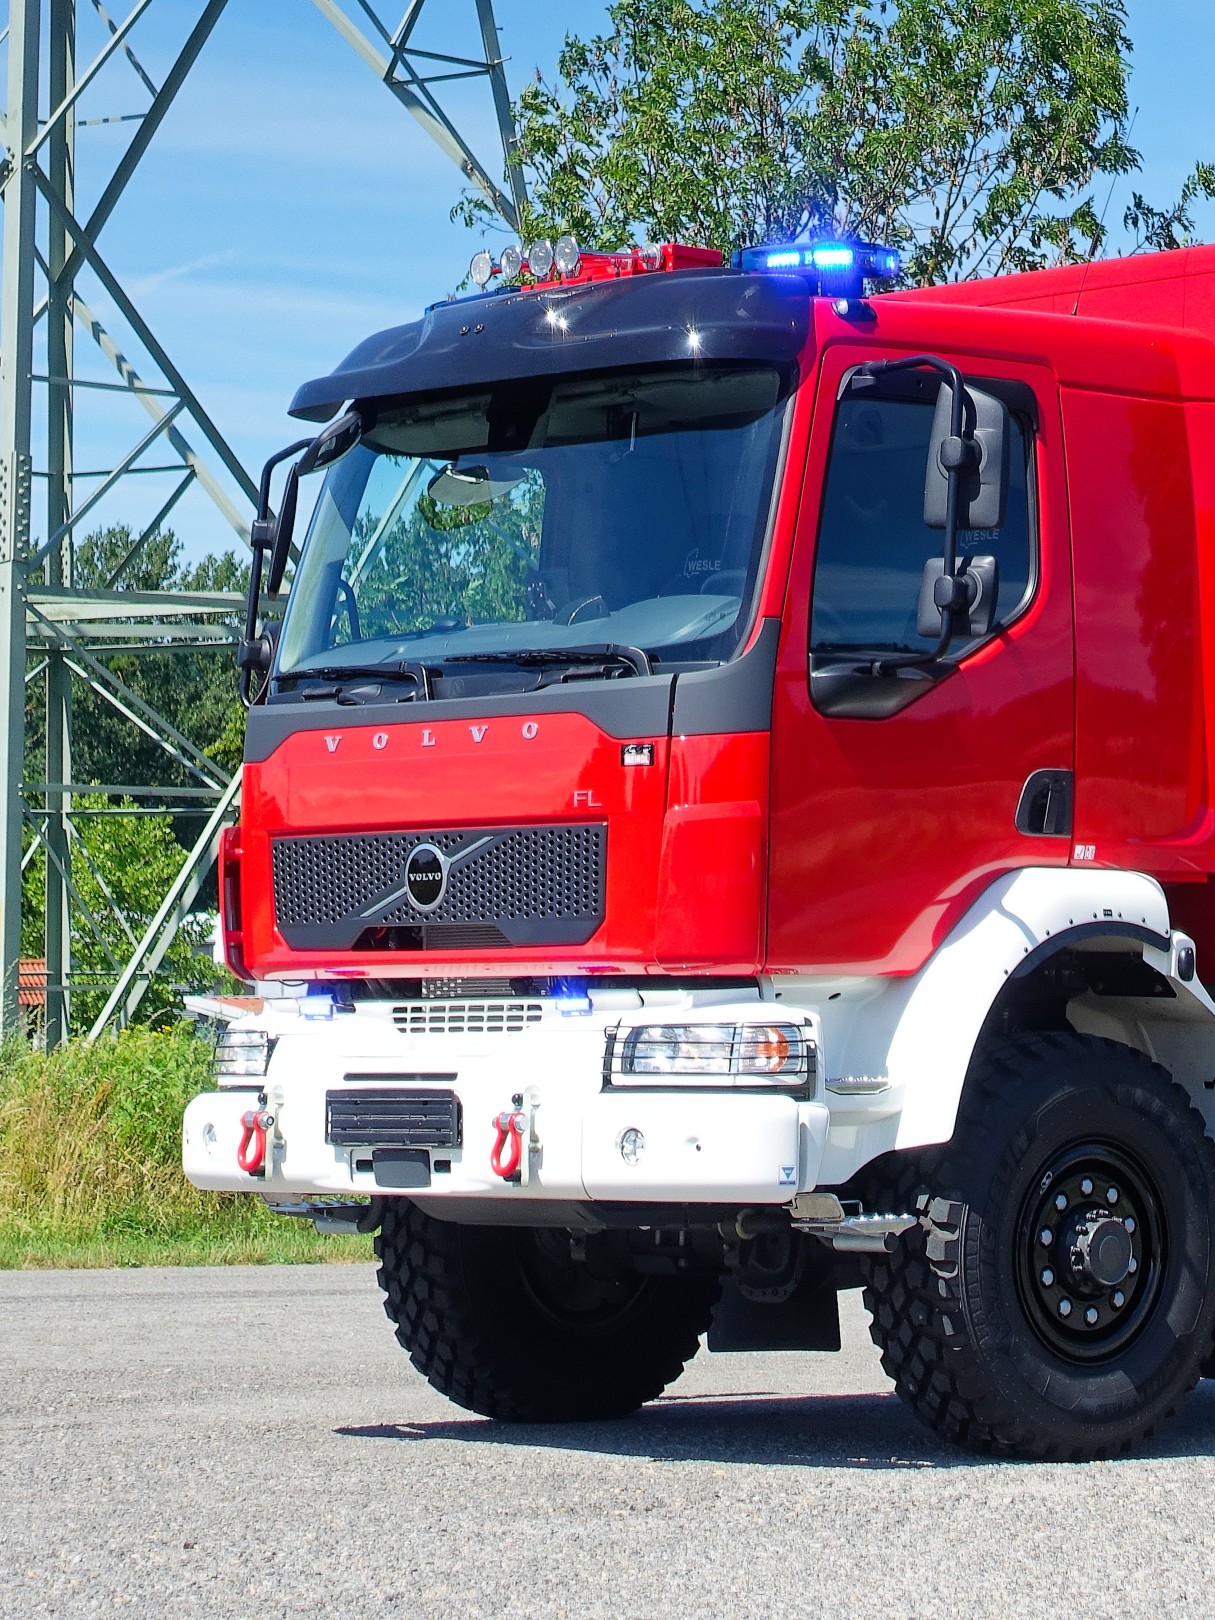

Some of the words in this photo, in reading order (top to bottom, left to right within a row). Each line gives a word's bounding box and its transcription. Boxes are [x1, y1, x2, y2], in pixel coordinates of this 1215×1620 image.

[965, 530, 1000, 541] WESLE
[688, 560, 721, 571] WESLE
[324, 721, 539, 753] VOLVO
[573, 790, 602, 808] FL
[409, 872, 441, 882] VOLVO
